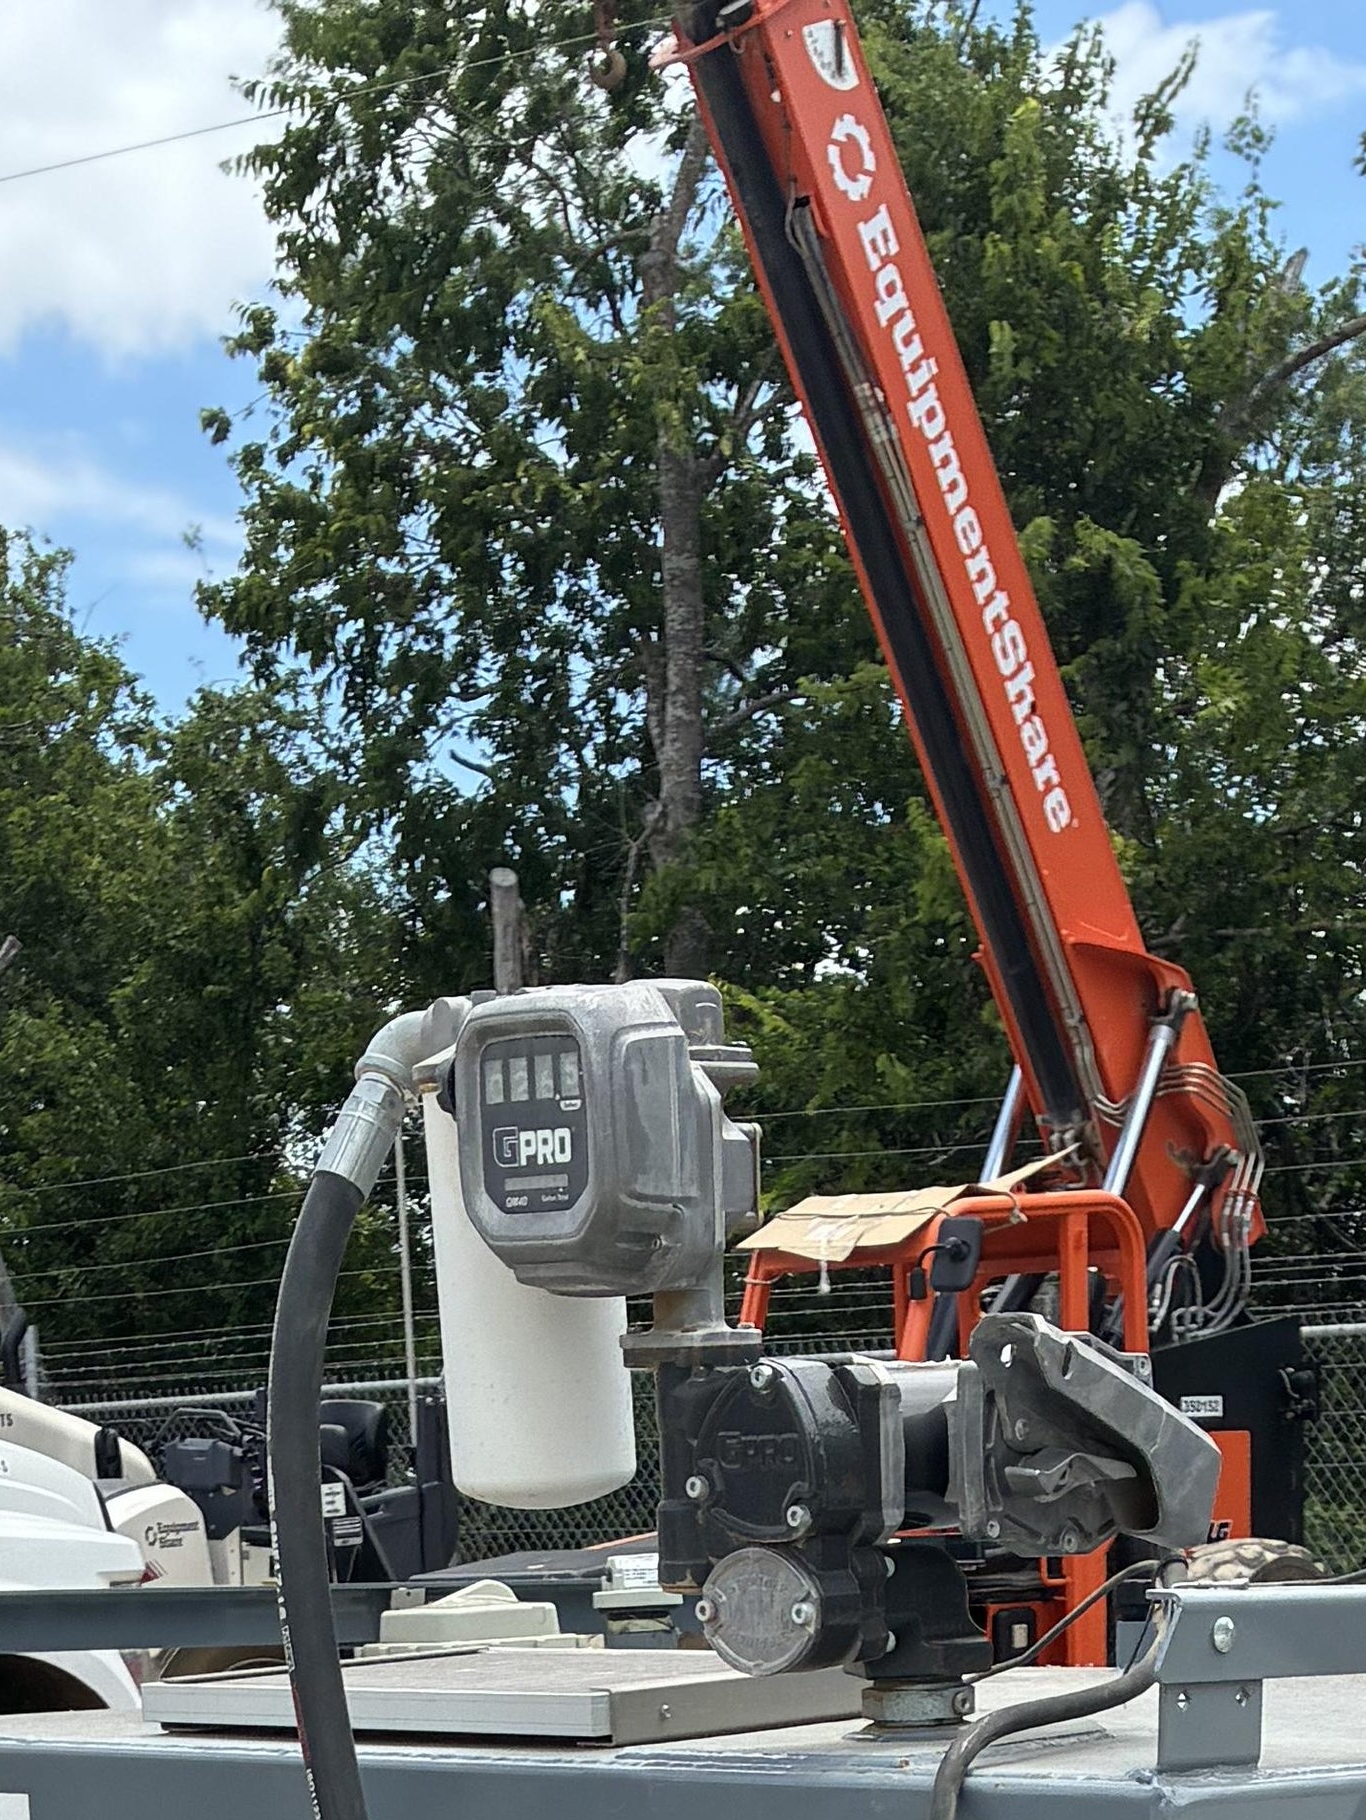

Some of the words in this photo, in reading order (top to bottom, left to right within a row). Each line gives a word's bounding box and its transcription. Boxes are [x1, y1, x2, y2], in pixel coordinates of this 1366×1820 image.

[857, 204, 1071, 834] EquipmentShare
[493, 1126, 572, 1168] GPRO
[1207, 1521, 1230, 1544] LG
